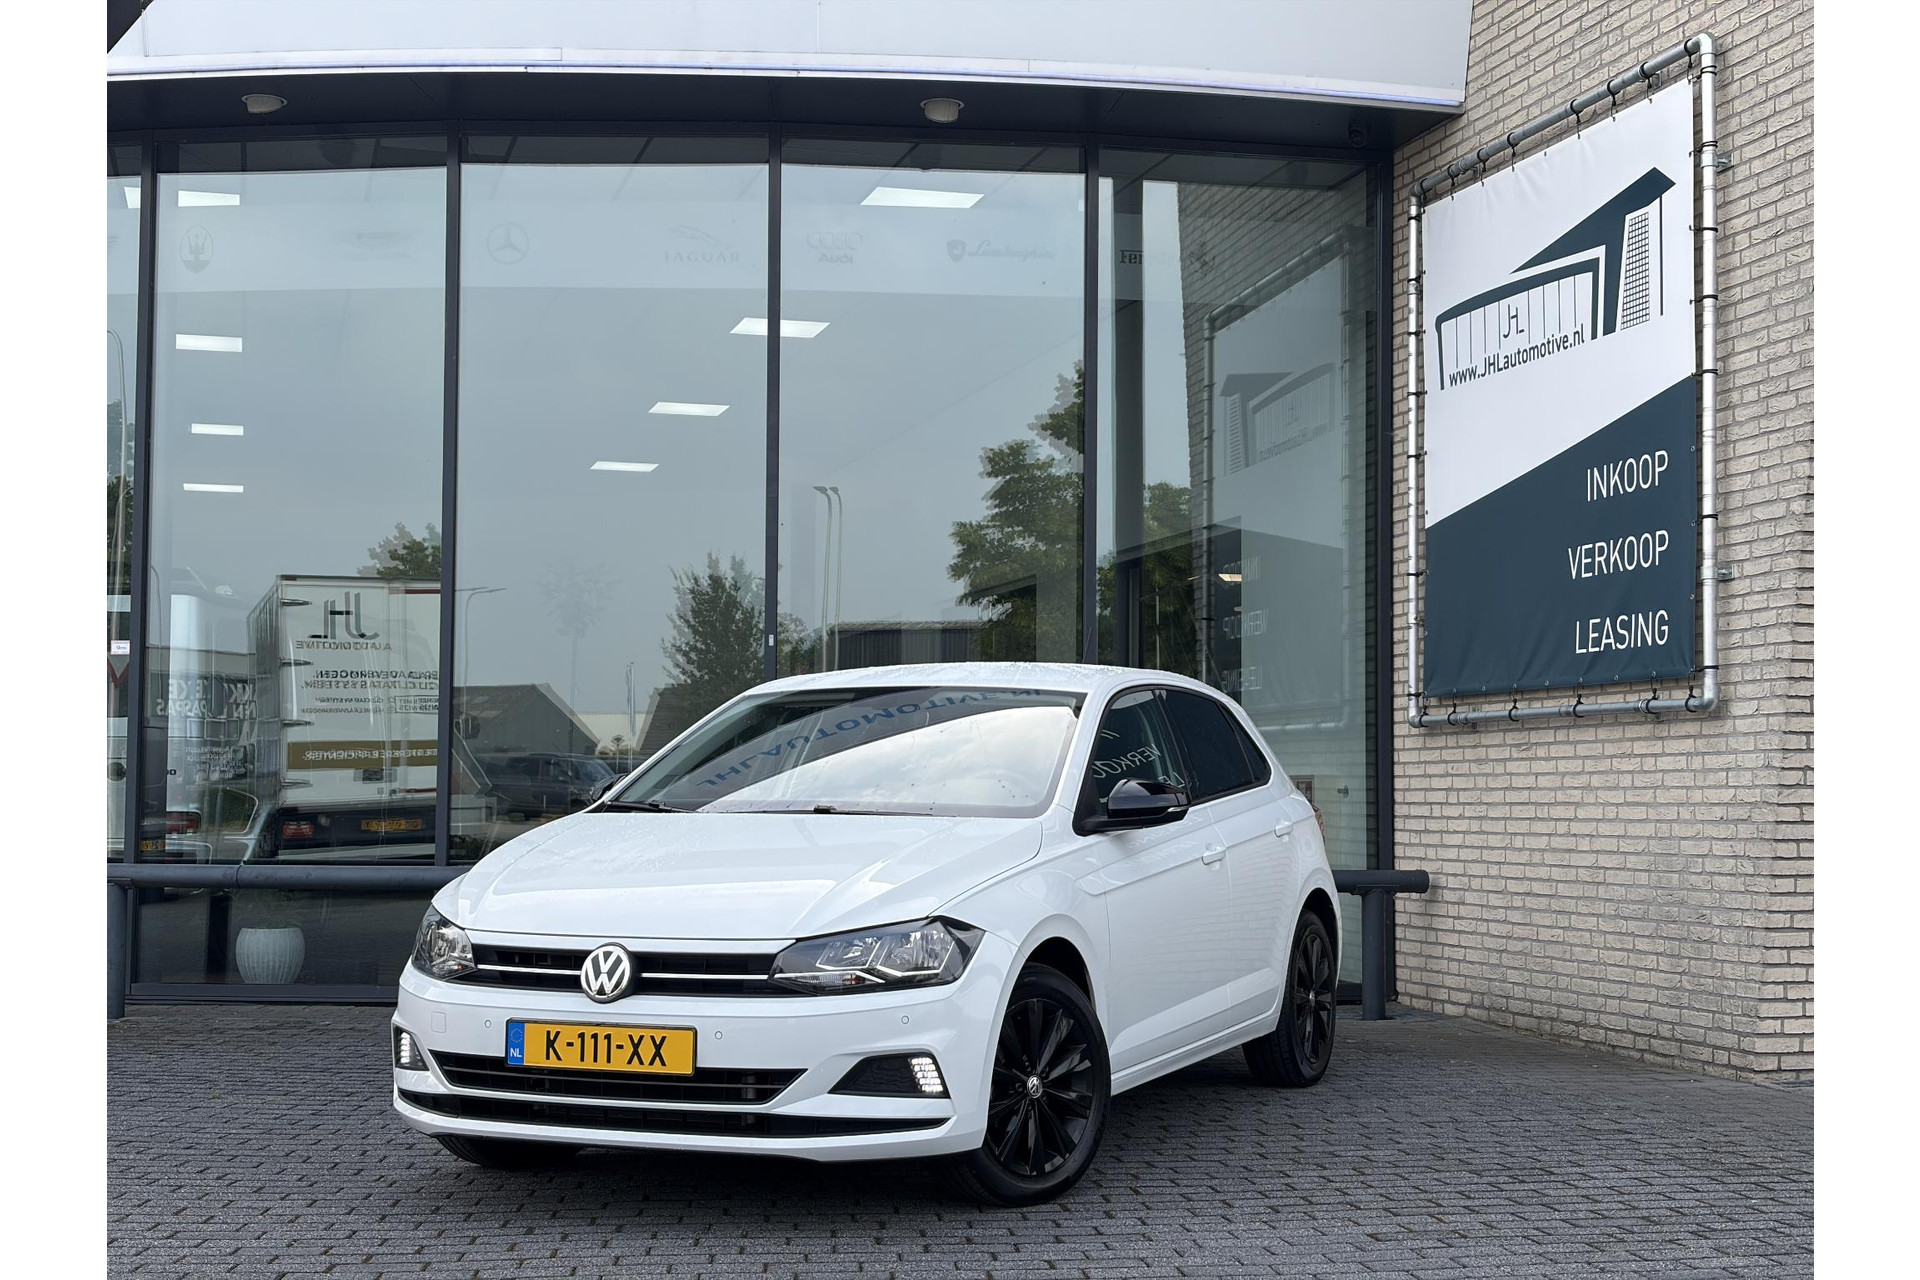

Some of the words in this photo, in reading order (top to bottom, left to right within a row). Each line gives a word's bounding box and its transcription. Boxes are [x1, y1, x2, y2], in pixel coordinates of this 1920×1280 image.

[817, 253, 855, 264] Audi
[1503, 304, 1525, 338] JHL
[1449, 323, 1585, 387] www.JHLautomotive.nl
[1587, 450, 1669, 502] INKOOP
[1568, 530, 1669, 580] VERKOOP
[1575, 610, 1669, 654] LEASING
[510, 1047, 523, 1058] NL
[545, 1029, 667, 1067] K-111-XX
